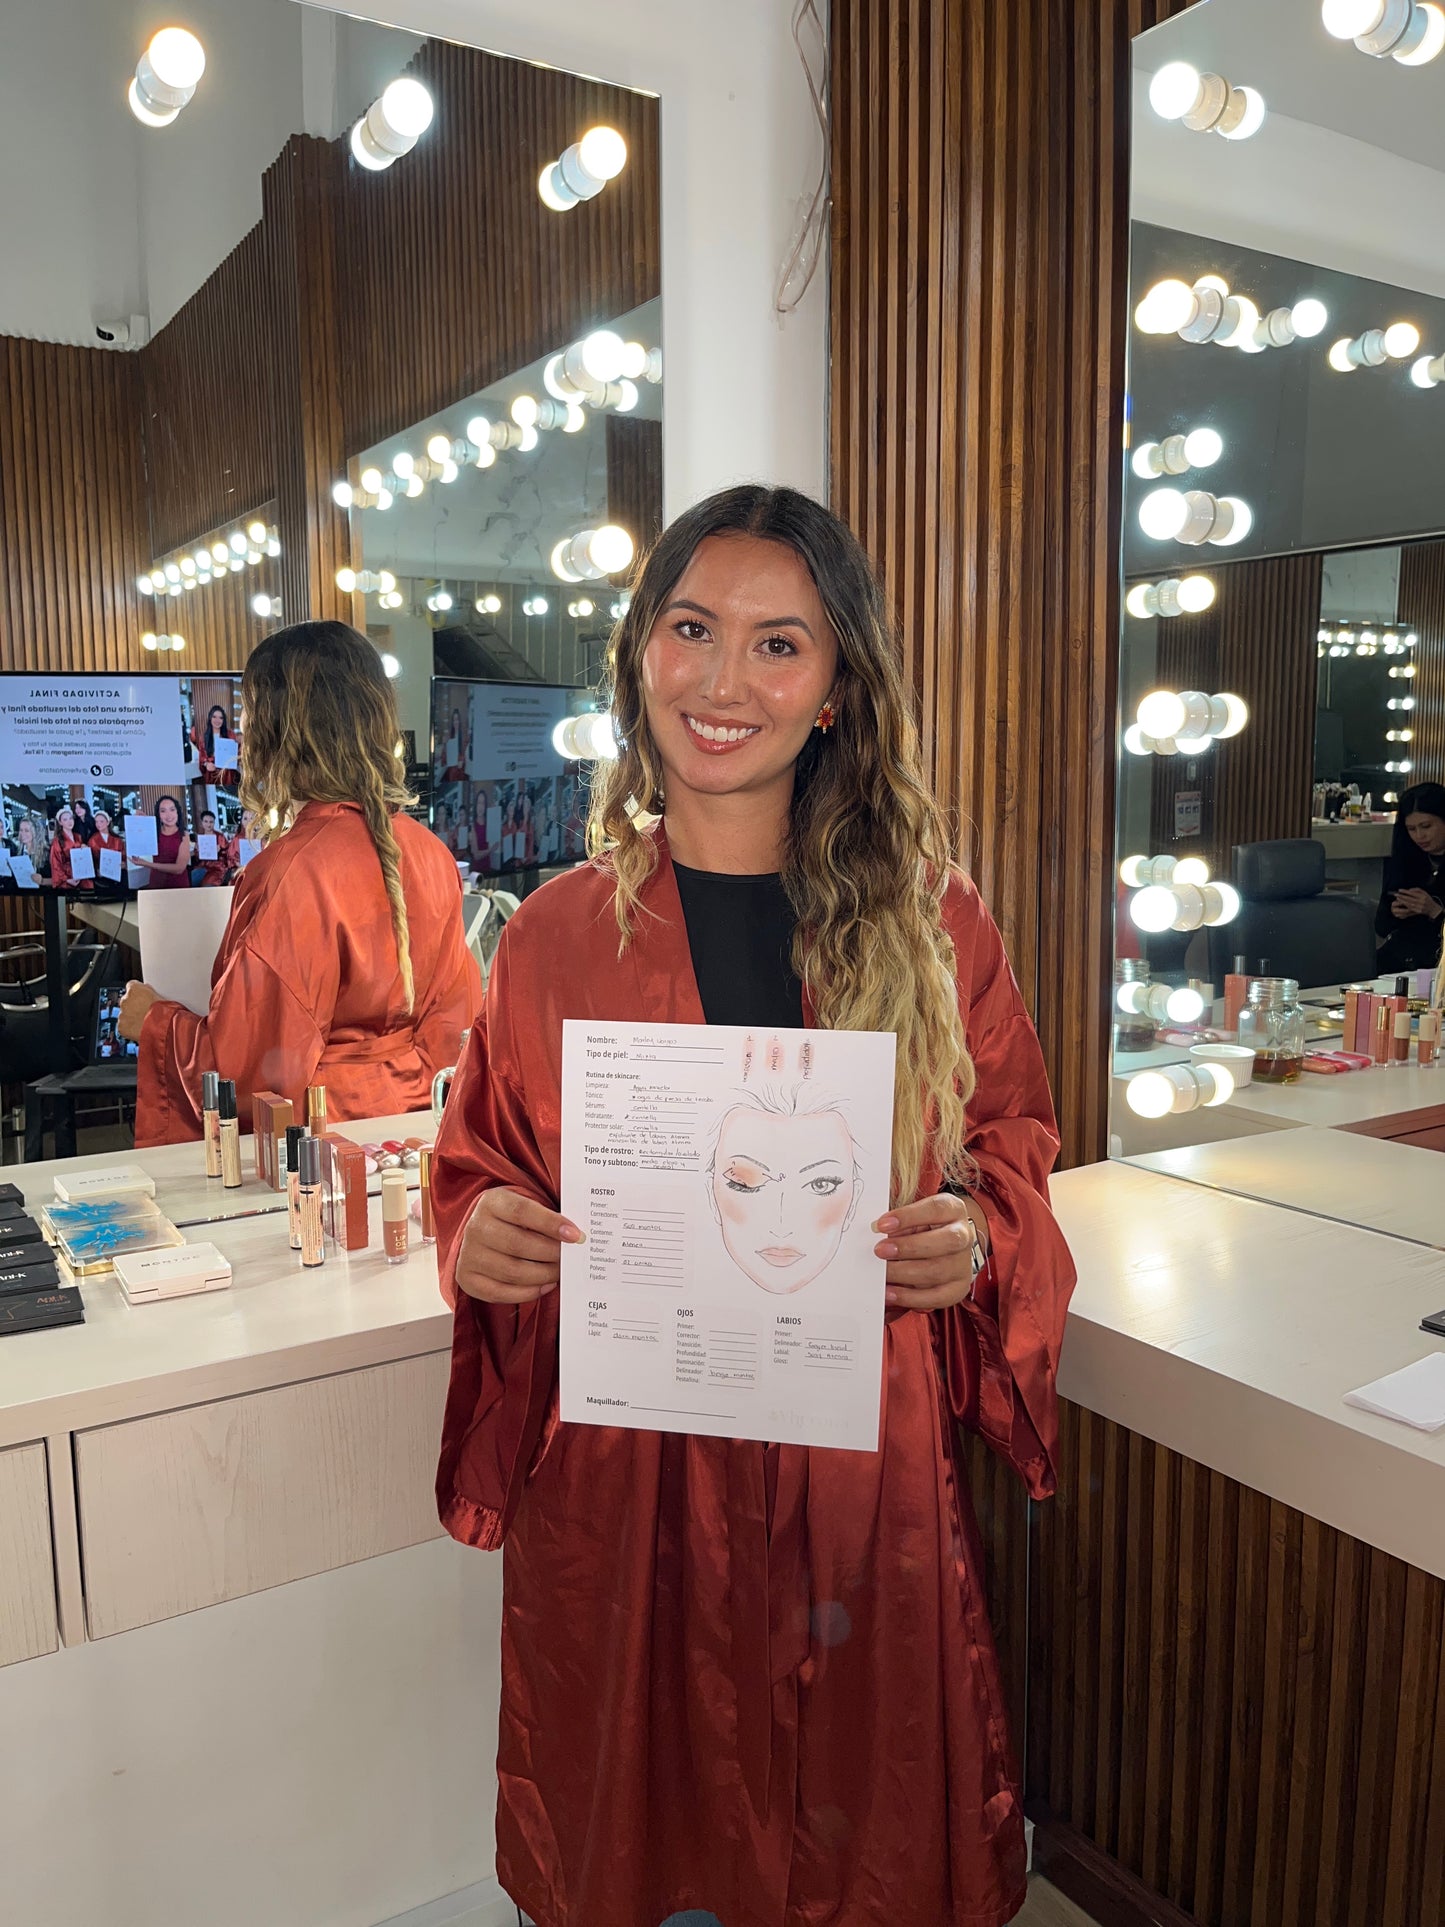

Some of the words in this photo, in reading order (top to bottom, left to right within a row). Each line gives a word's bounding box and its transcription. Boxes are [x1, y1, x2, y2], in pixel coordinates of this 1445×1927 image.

[587, 1036, 618, 1044] Nombre:
[586, 1049, 601, 1059] Tipo
[613, 1051, 629, 1060] piel:
[585, 1112, 614, 1120] Hidratante:
[584, 1145, 599, 1154] Tipo
[610, 1147, 634, 1155] rostro:
[584, 1157, 601, 1165] Tono
[608, 1158, 639, 1167] subtono:
[590, 1188, 615, 1196] ROSTRO
[588, 1301, 608, 1310] CEJAS
[677, 1309, 694, 1317] OJOS
[776, 1316, 802, 1326] LABIOS
[586, 1396, 630, 1407] Maquillador:
